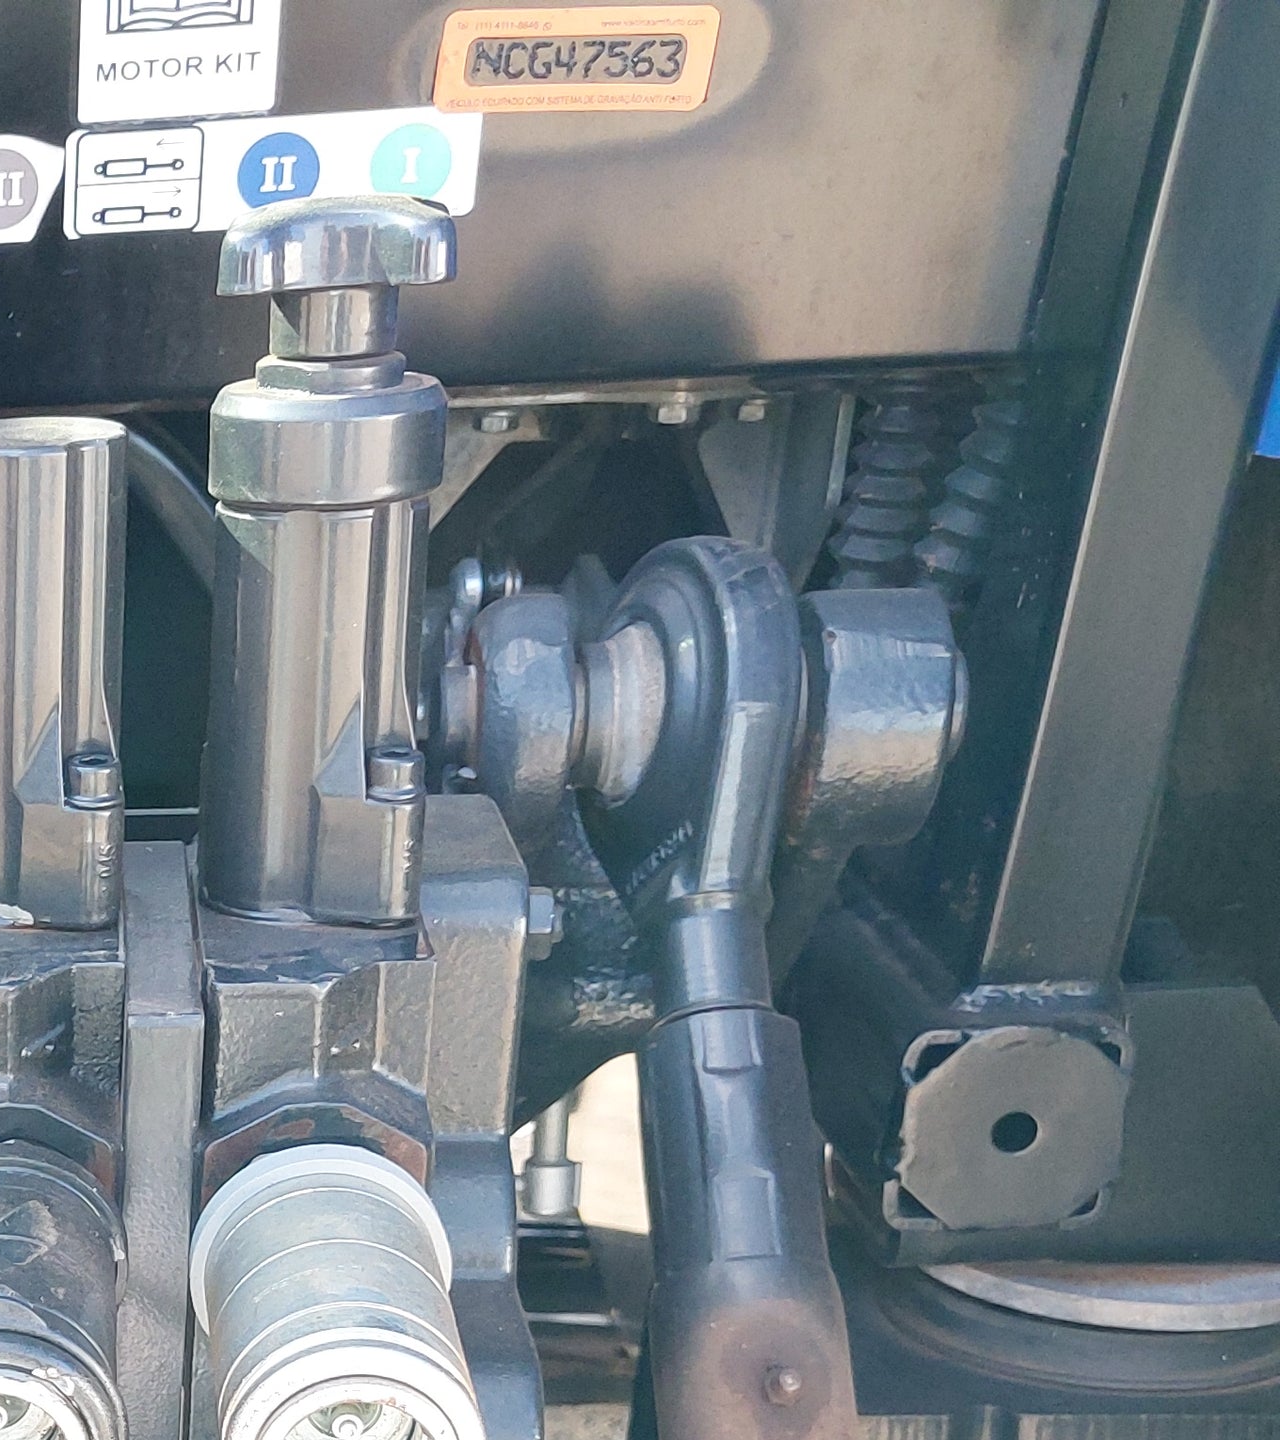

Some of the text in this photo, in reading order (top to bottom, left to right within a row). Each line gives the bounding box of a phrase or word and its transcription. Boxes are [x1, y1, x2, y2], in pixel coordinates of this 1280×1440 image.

[96, 51, 262, 82] MOTOR KIT
[471, 39, 684, 80] NCG47563
[259, 155, 299, 193] II
